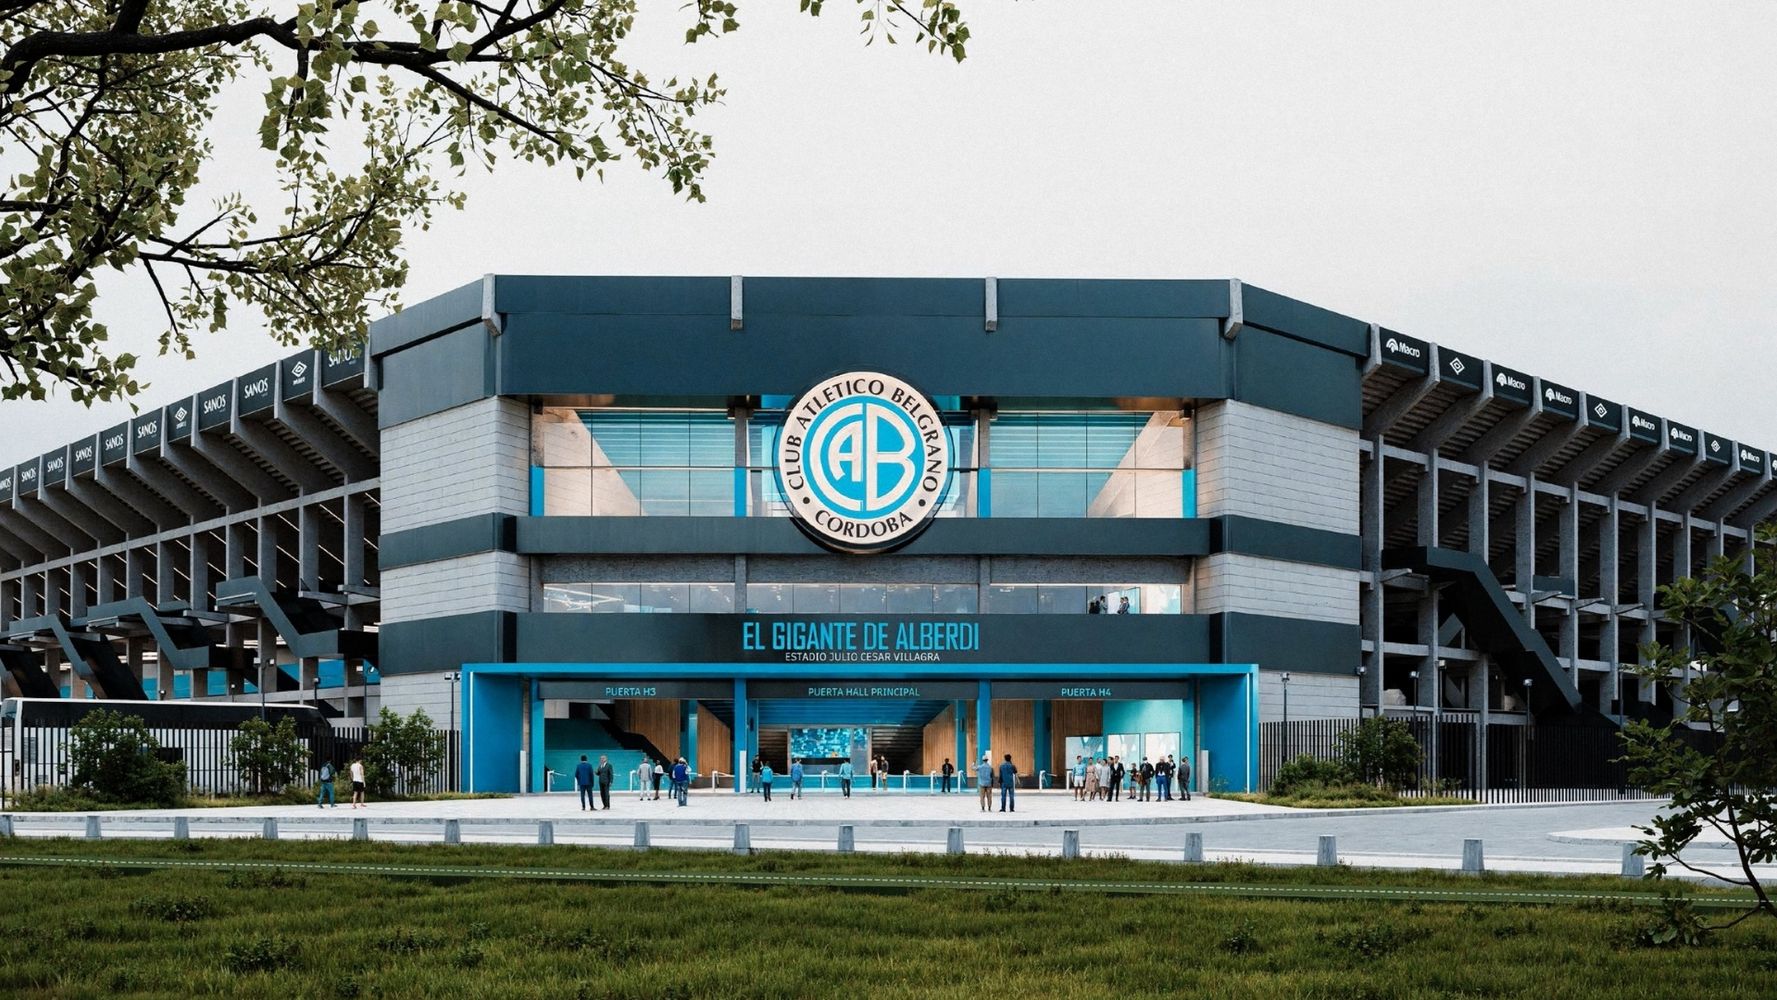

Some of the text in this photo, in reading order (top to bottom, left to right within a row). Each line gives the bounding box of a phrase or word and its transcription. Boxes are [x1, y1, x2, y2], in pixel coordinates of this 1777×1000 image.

[1399, 342, 1420, 358] Macro
[244, 378, 268, 399] SANOS
[1507, 376, 1526, 390] Macro
[203, 394, 226, 414] SANOS
[1555, 391, 1573, 405] Macro
[137, 420, 157, 439] SANOS
[784, 379, 942, 493] CLUB ATLETICO BELGRANO
[105, 433, 124, 451] SANOS
[75, 445, 93, 462] SANOS
[47, 457, 64, 473] SANOS
[815, 509, 914, 538] CORDOBA
[743, 622, 980, 650] EL GIGANTE DE ALBERDI
[785, 652, 940, 662] ESTADIO JULIO CESAR VILLAGRA
[605, 687, 657, 696] PUERTA H3
[808, 687, 920, 697] PUERTA HALL PRINCIPAL
[1061, 687, 1112, 697] PUERTA H4
